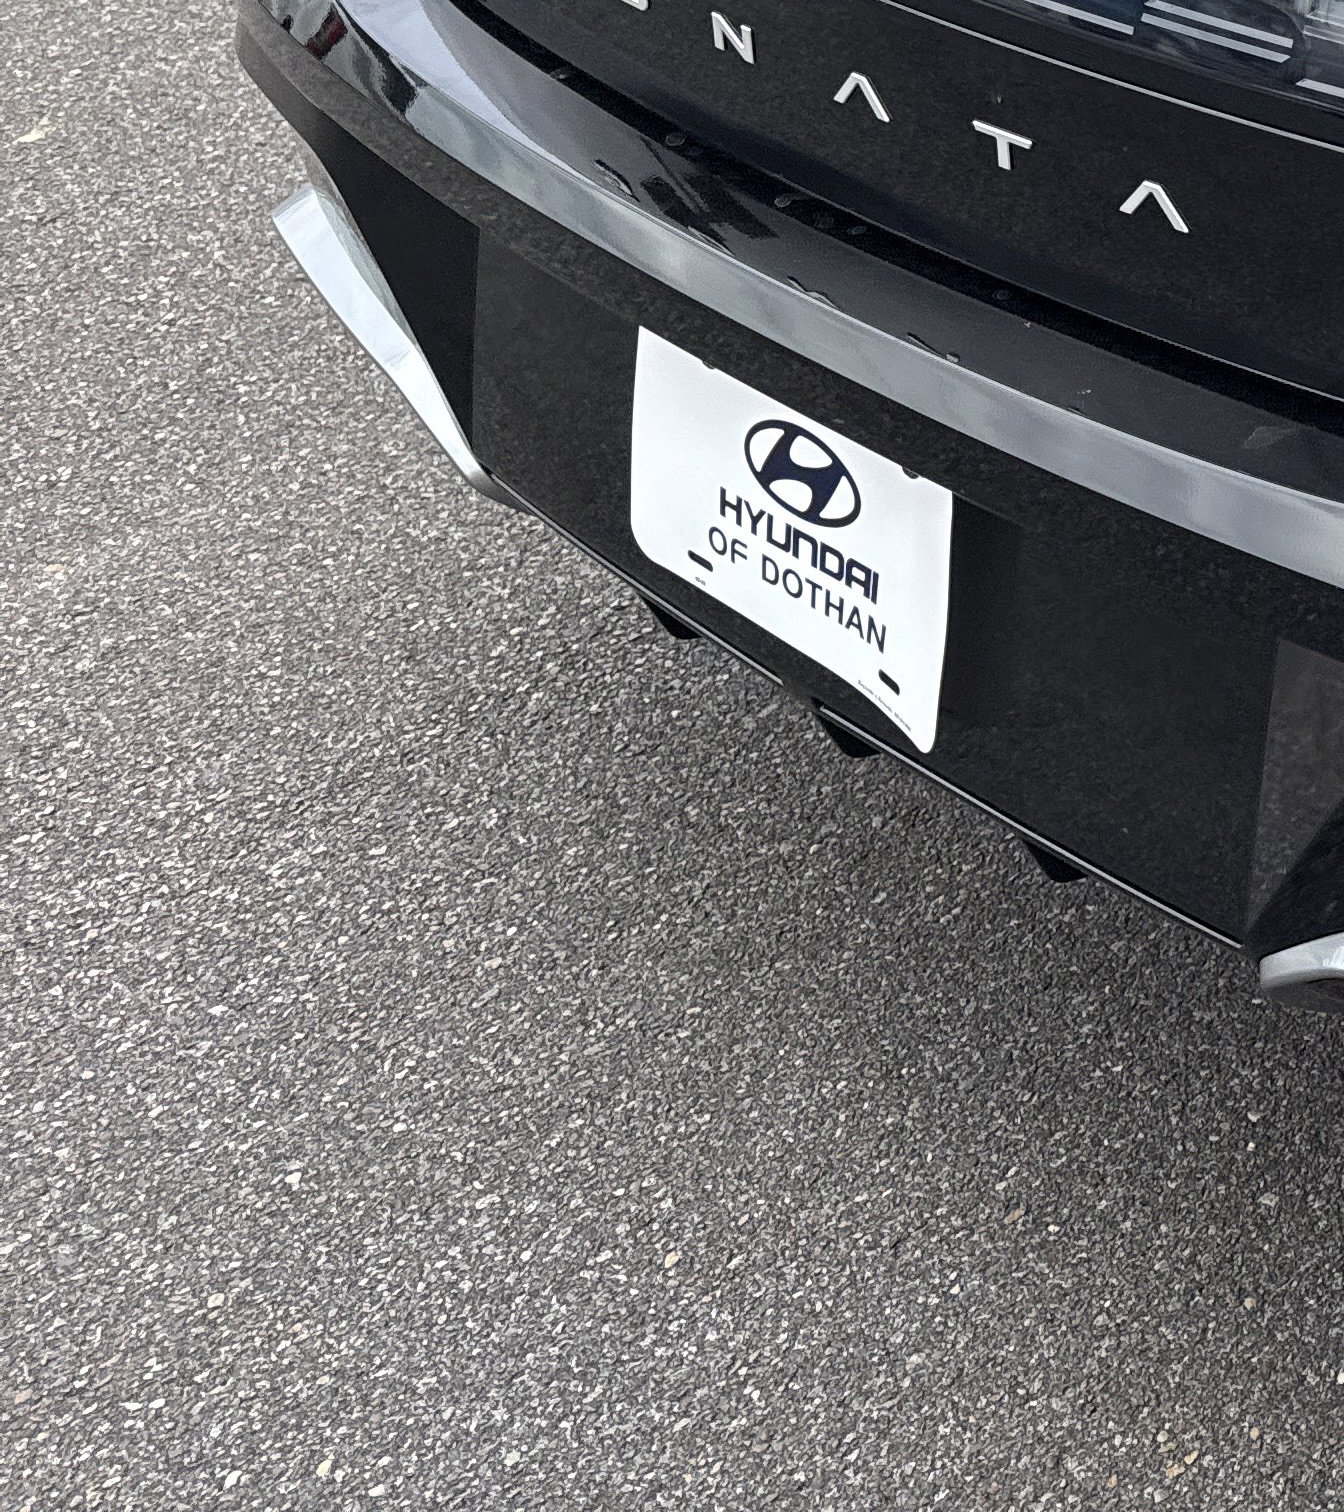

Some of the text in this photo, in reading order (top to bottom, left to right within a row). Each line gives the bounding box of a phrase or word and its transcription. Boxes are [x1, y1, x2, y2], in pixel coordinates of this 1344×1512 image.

[708, 525, 887, 655] OF DOTHAN
[719, 486, 880, 606] HYUNDAI
